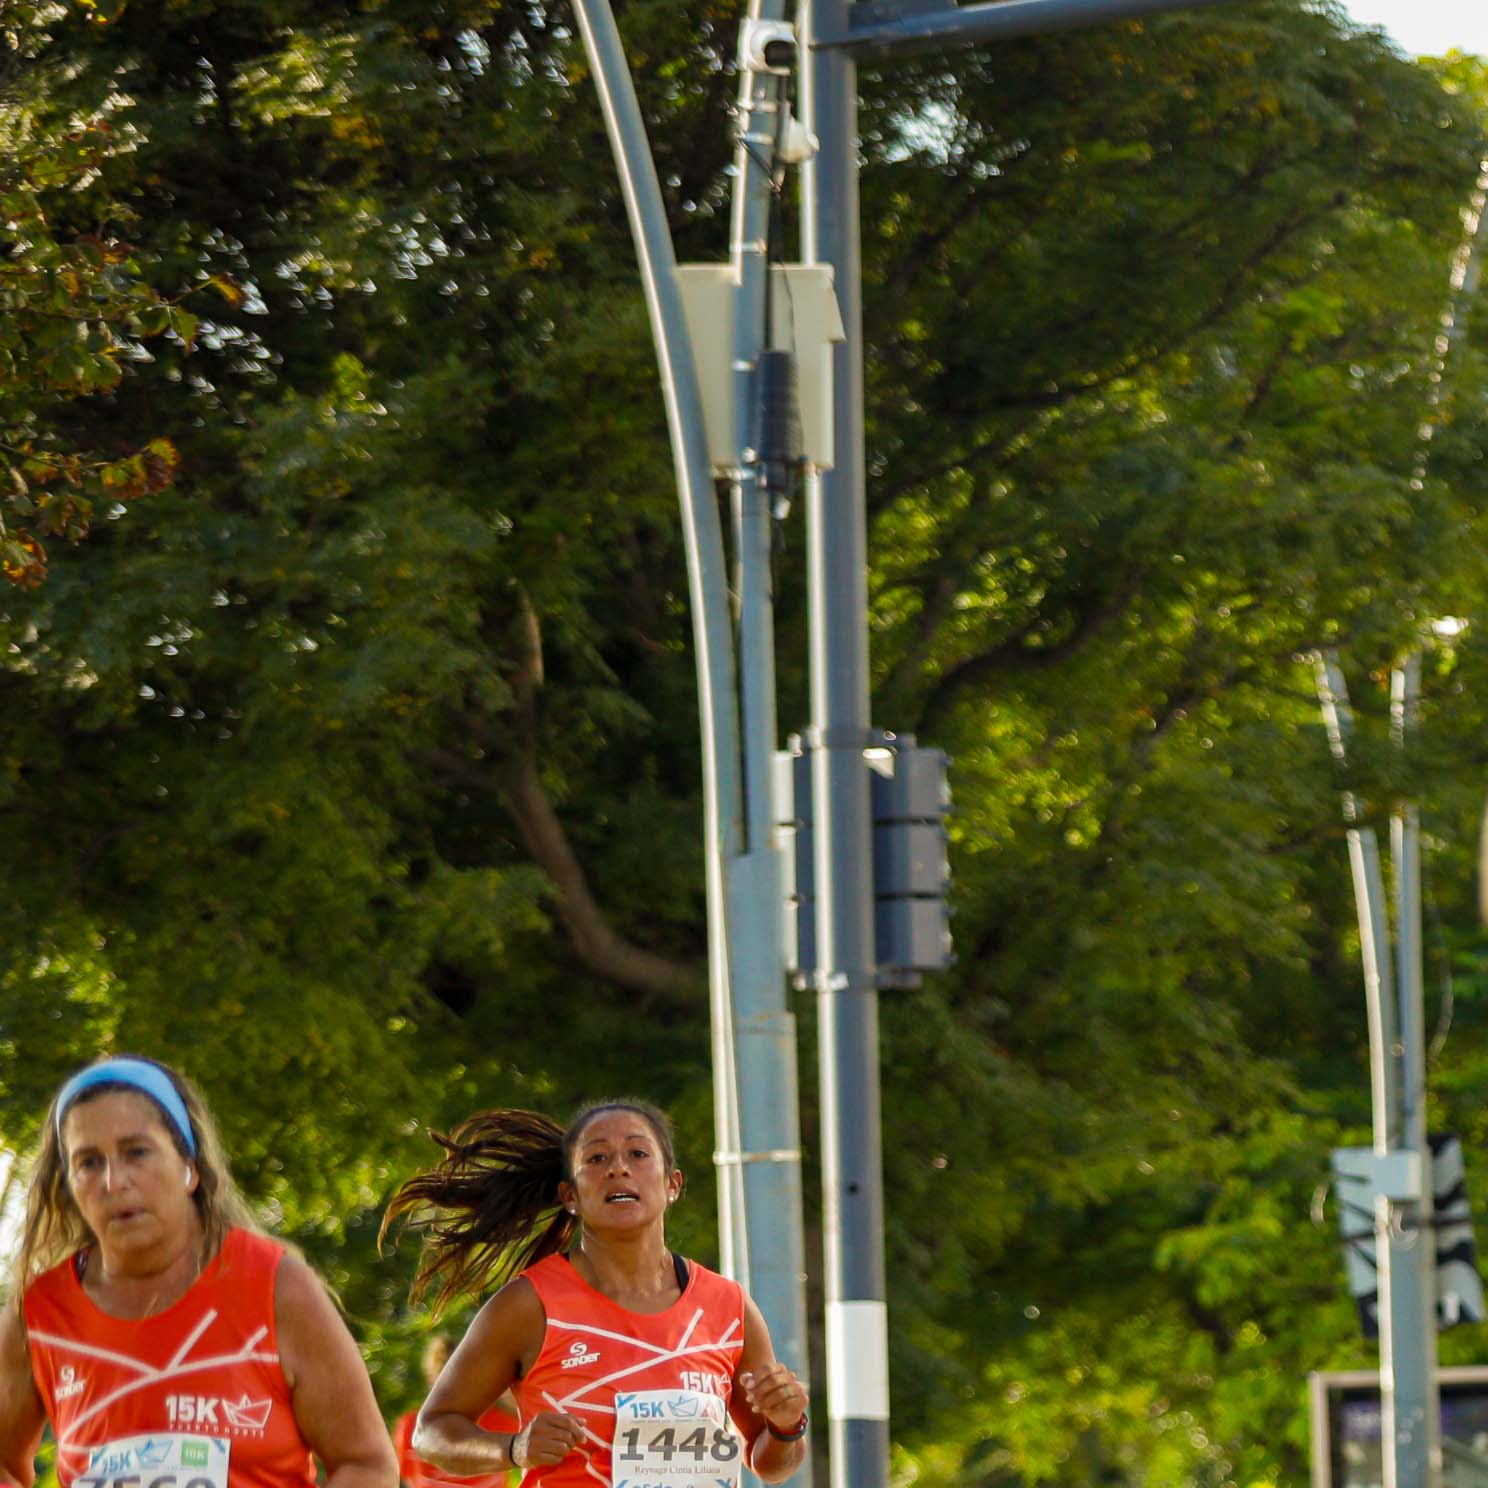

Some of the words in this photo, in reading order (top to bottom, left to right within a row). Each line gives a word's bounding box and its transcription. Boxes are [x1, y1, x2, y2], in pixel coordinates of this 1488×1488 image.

[679, 1371, 712, 1394] 15K
[165, 1394, 219, 1424] 15K
[630, 1402, 665, 1418] 15K
[619, 1427, 739, 1462] 1448
